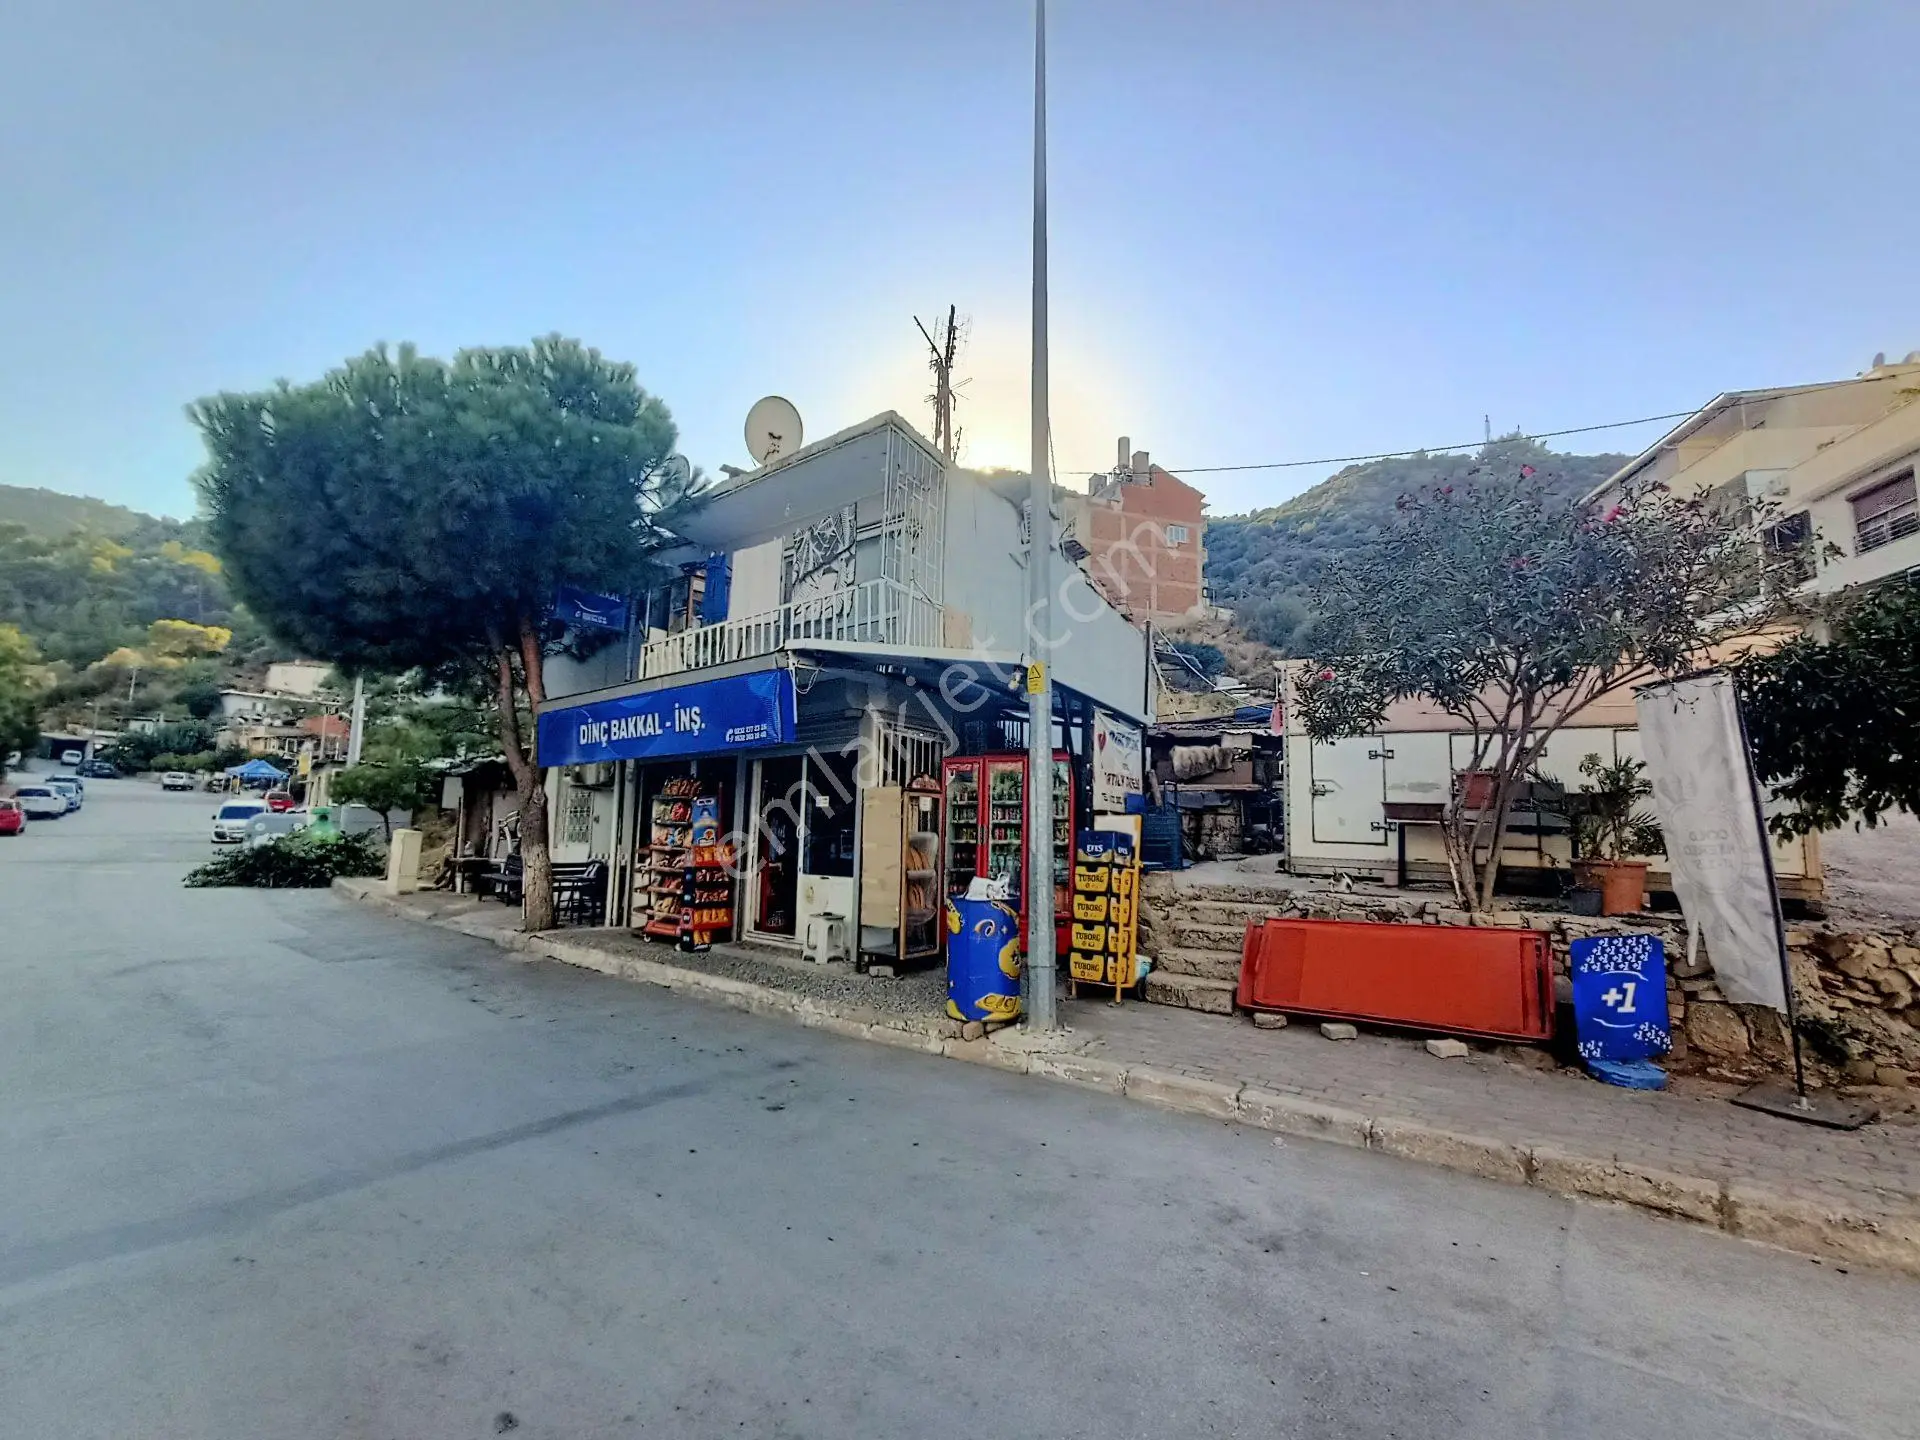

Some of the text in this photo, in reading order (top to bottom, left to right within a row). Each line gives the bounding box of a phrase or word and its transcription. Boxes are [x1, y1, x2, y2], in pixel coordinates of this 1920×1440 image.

[579, 717, 608, 748] DİNÇ
[610, 711, 663, 740] BAKKAL
[674, 703, 706, 737] İNŞ.
[1078, 873, 1104, 883] TUBORG
[1077, 903, 1103, 912] TUBORG
[1075, 932, 1101, 942] TUBORG
[1073, 961, 1100, 971] TUBORG
[1601, 982, 1636, 1013] +1
